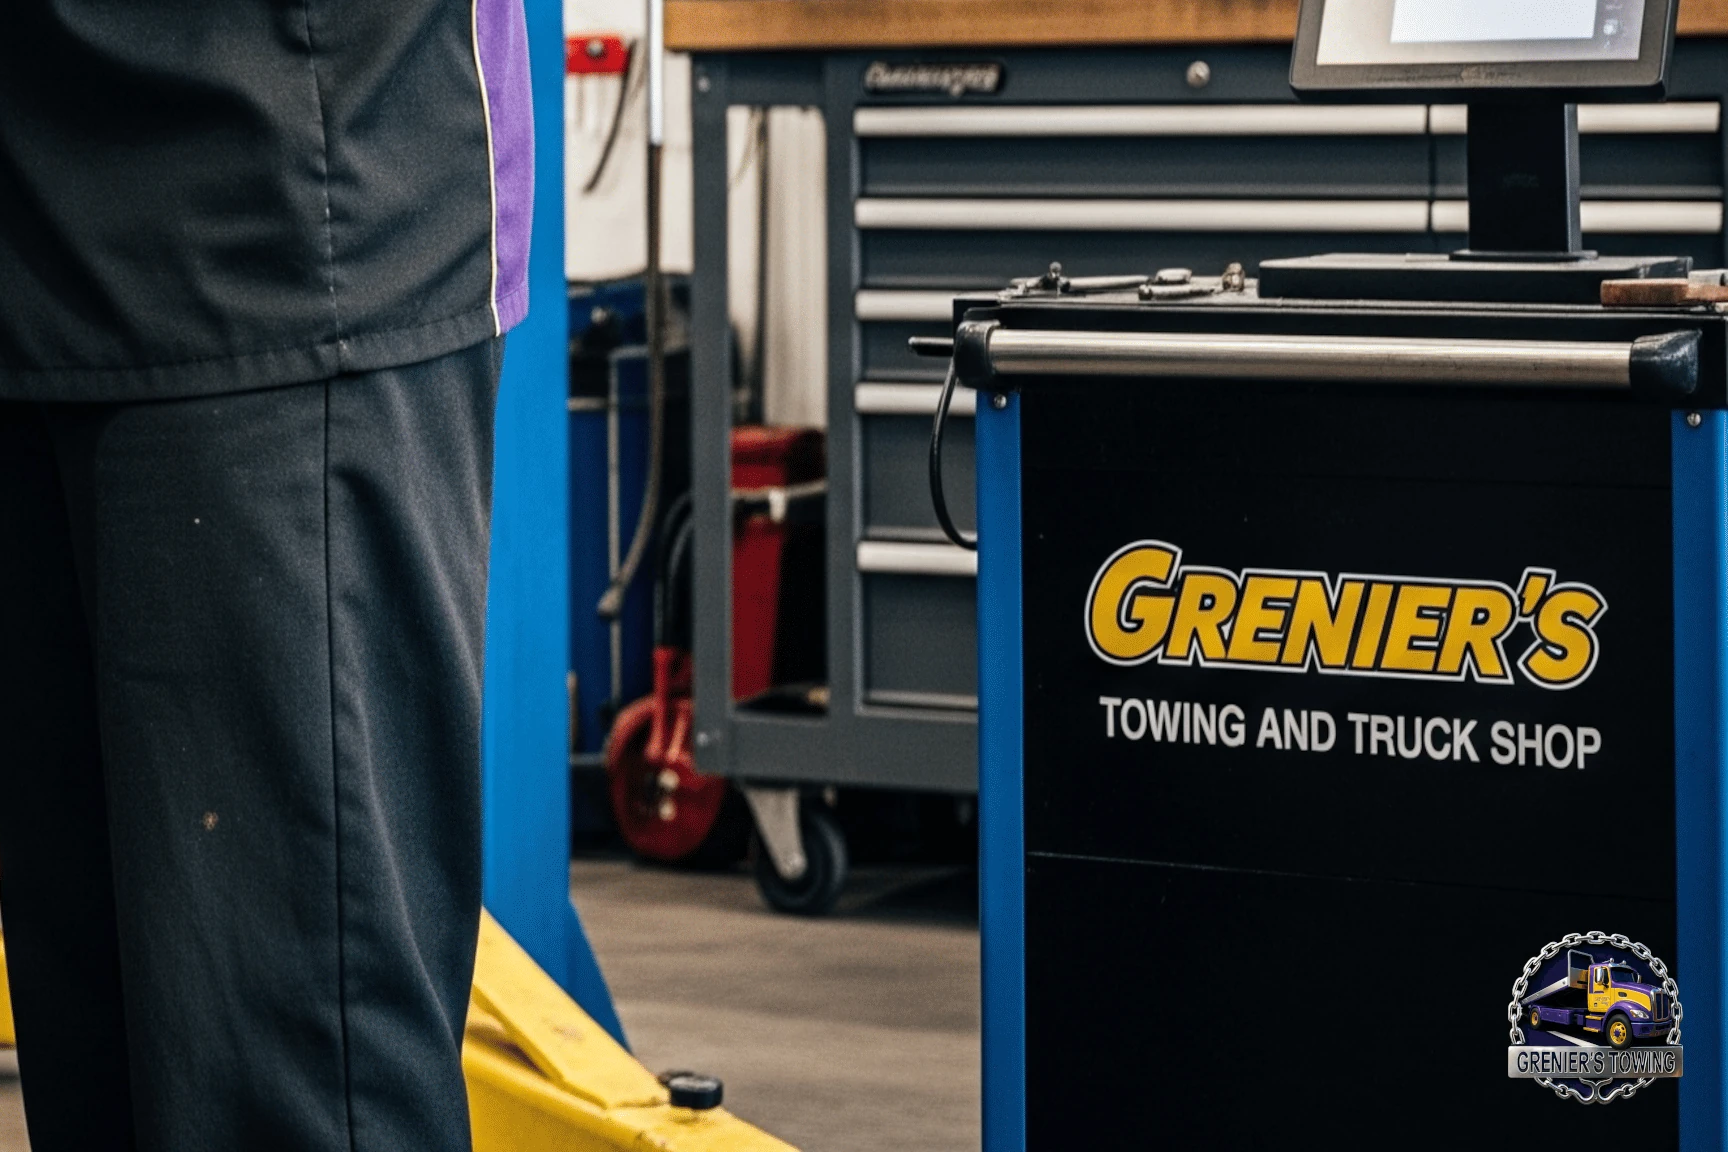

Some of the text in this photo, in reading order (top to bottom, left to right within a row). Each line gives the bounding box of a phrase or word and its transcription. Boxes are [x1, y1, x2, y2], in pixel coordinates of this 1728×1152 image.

[1084, 538, 1608, 691] GRENIER'S
[1099, 696, 1603, 770] TOWING AND TRUCK SHOP
